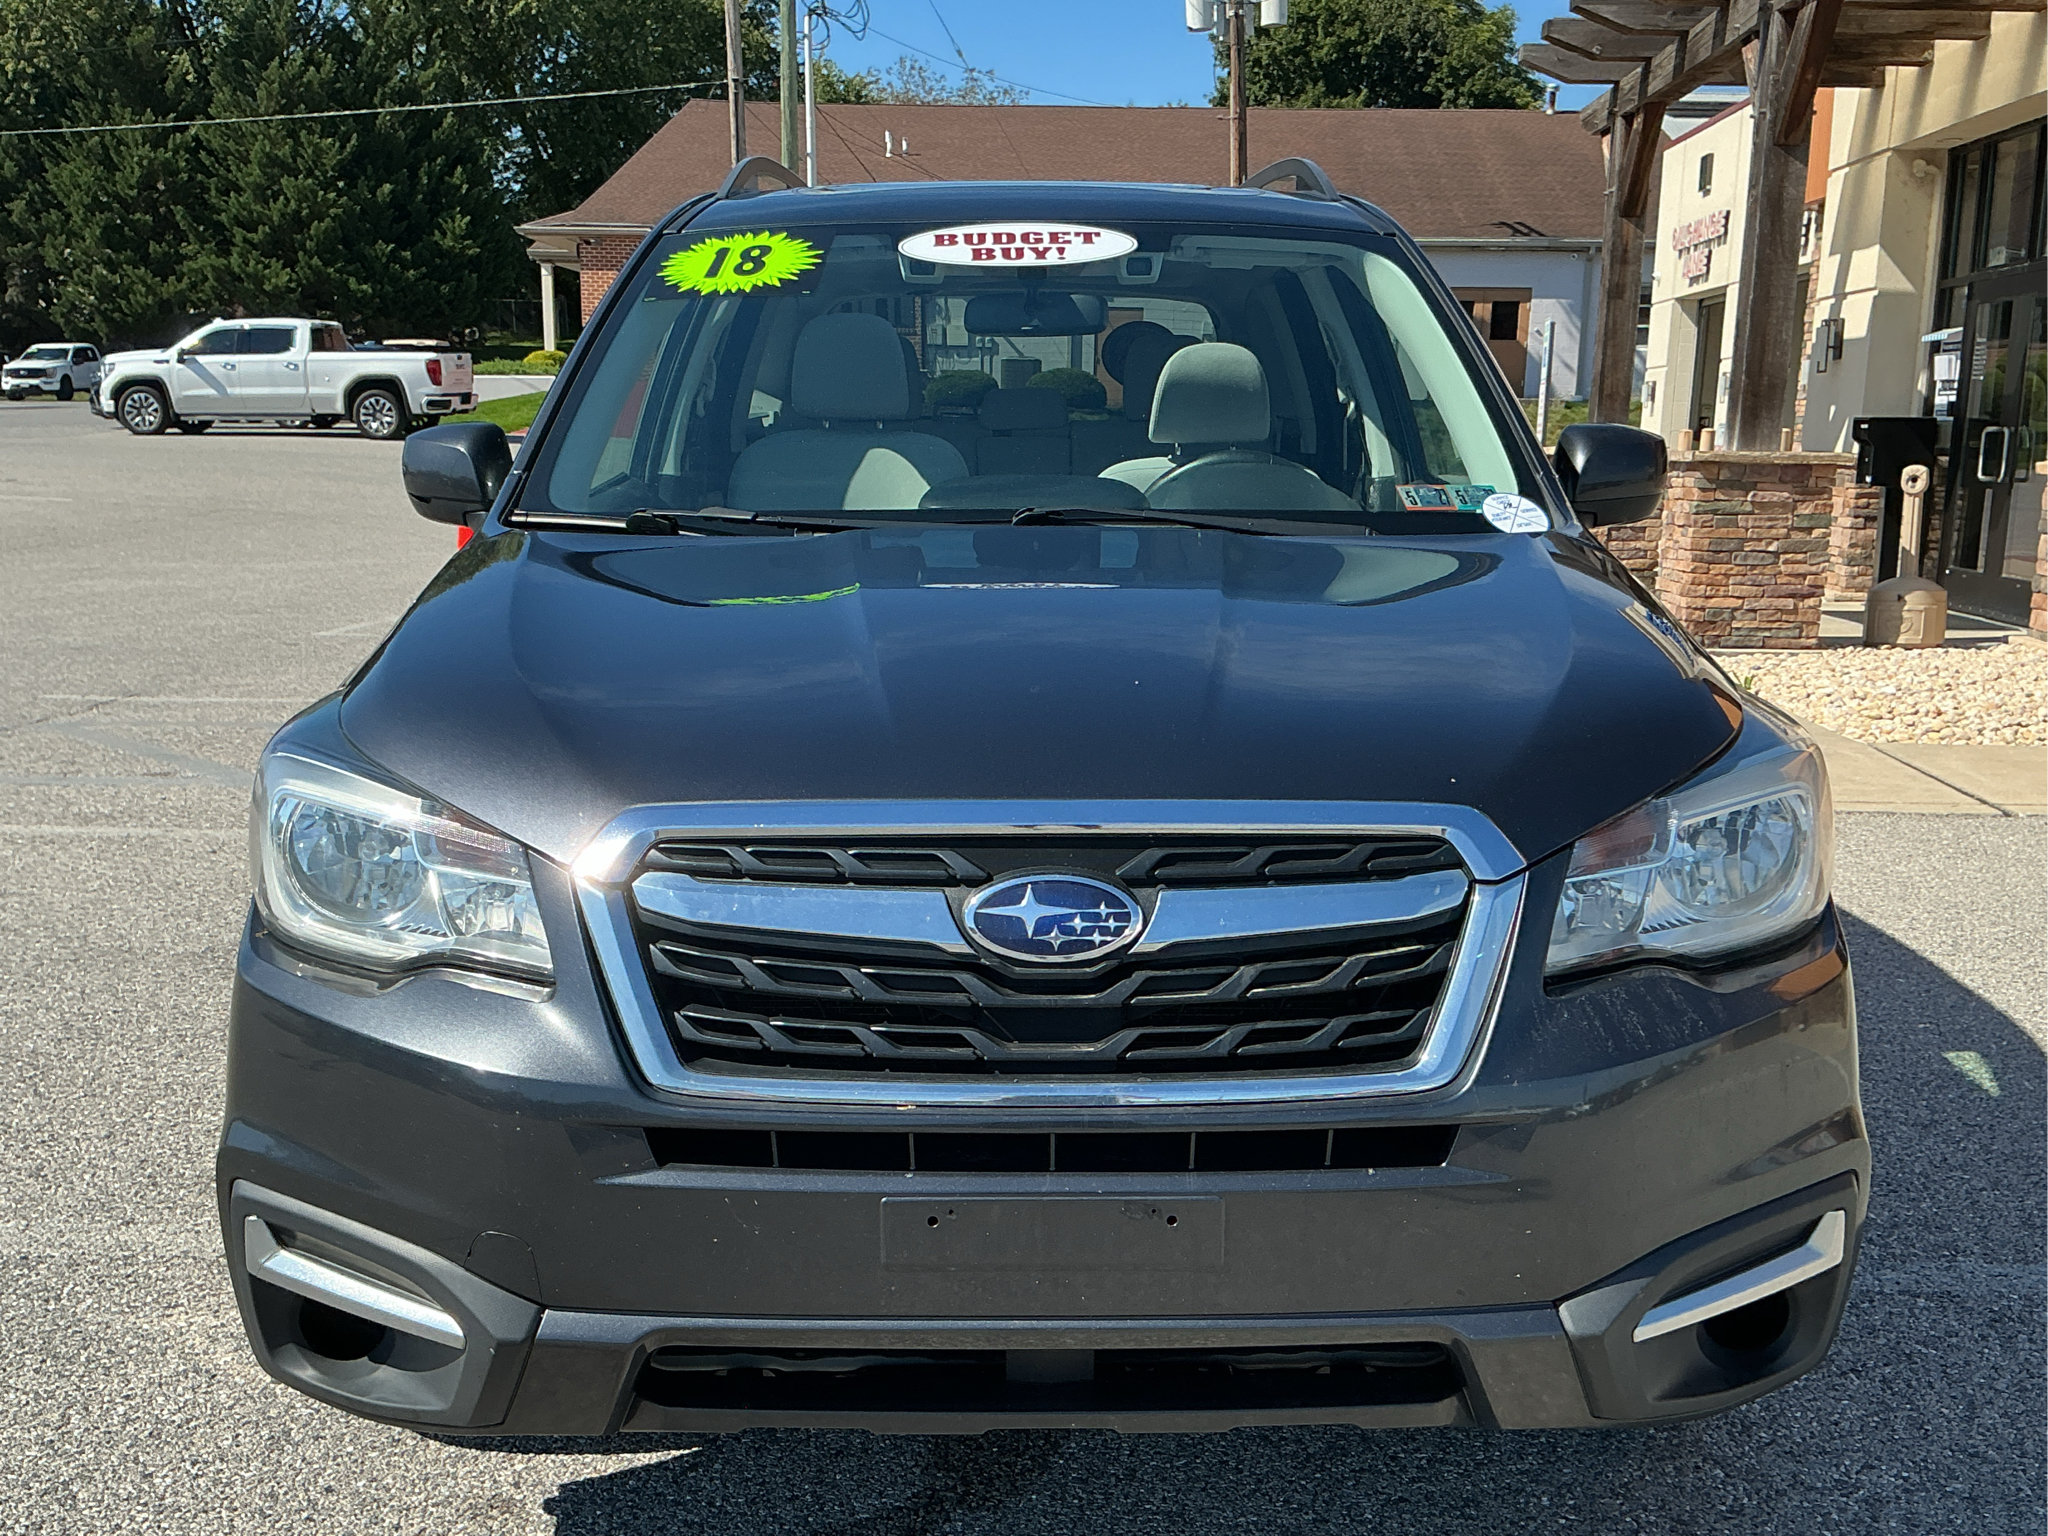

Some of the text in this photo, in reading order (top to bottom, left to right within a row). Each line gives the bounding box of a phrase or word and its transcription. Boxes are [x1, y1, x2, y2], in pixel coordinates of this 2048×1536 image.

[933, 231, 1101, 247] BUDGET
[704, 244, 772, 278] 18
[971, 246, 1066, 261] BUY!
[1405, 490, 1418, 506] 5
[1455, 489, 1468, 505] 5
